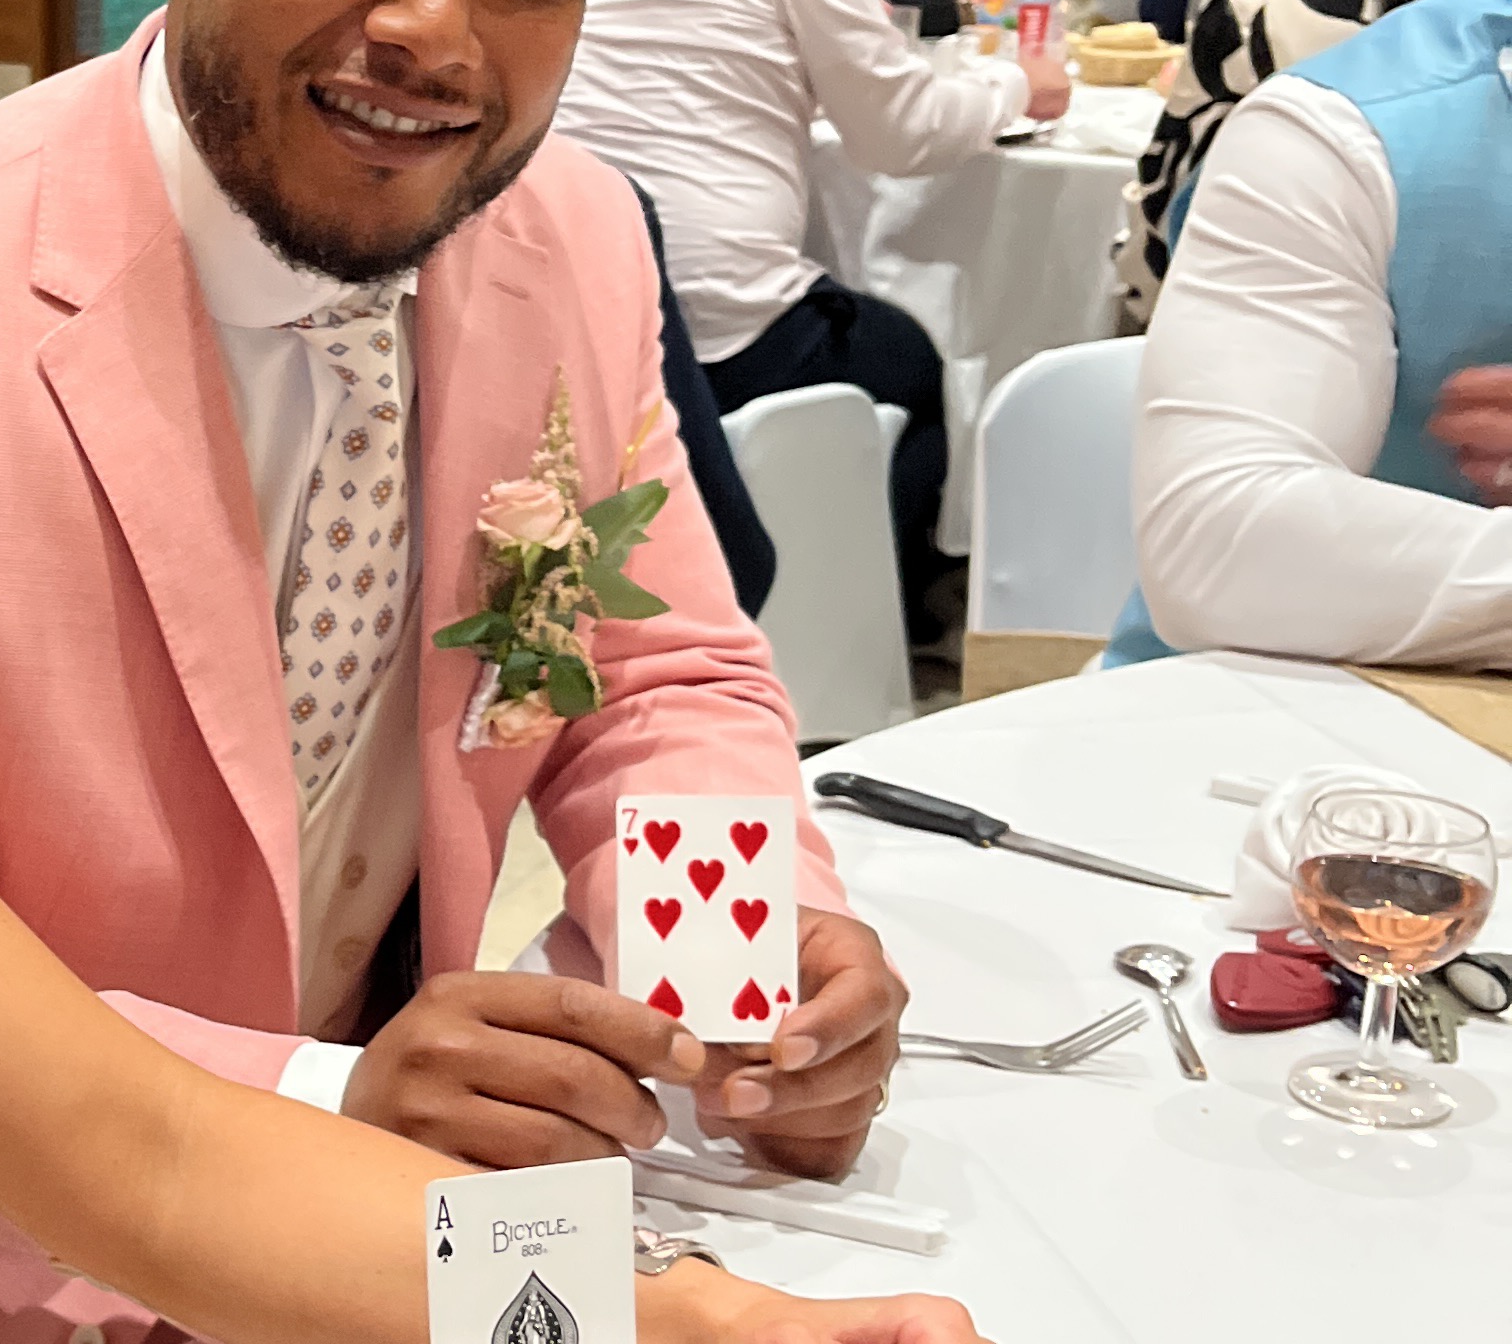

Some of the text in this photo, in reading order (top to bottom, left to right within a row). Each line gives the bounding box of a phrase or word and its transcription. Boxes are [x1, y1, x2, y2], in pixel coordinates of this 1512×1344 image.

[622, 808, 638, 834] 7
[434, 1195, 454, 1230] A
[521, 1242, 543, 1257] 808
